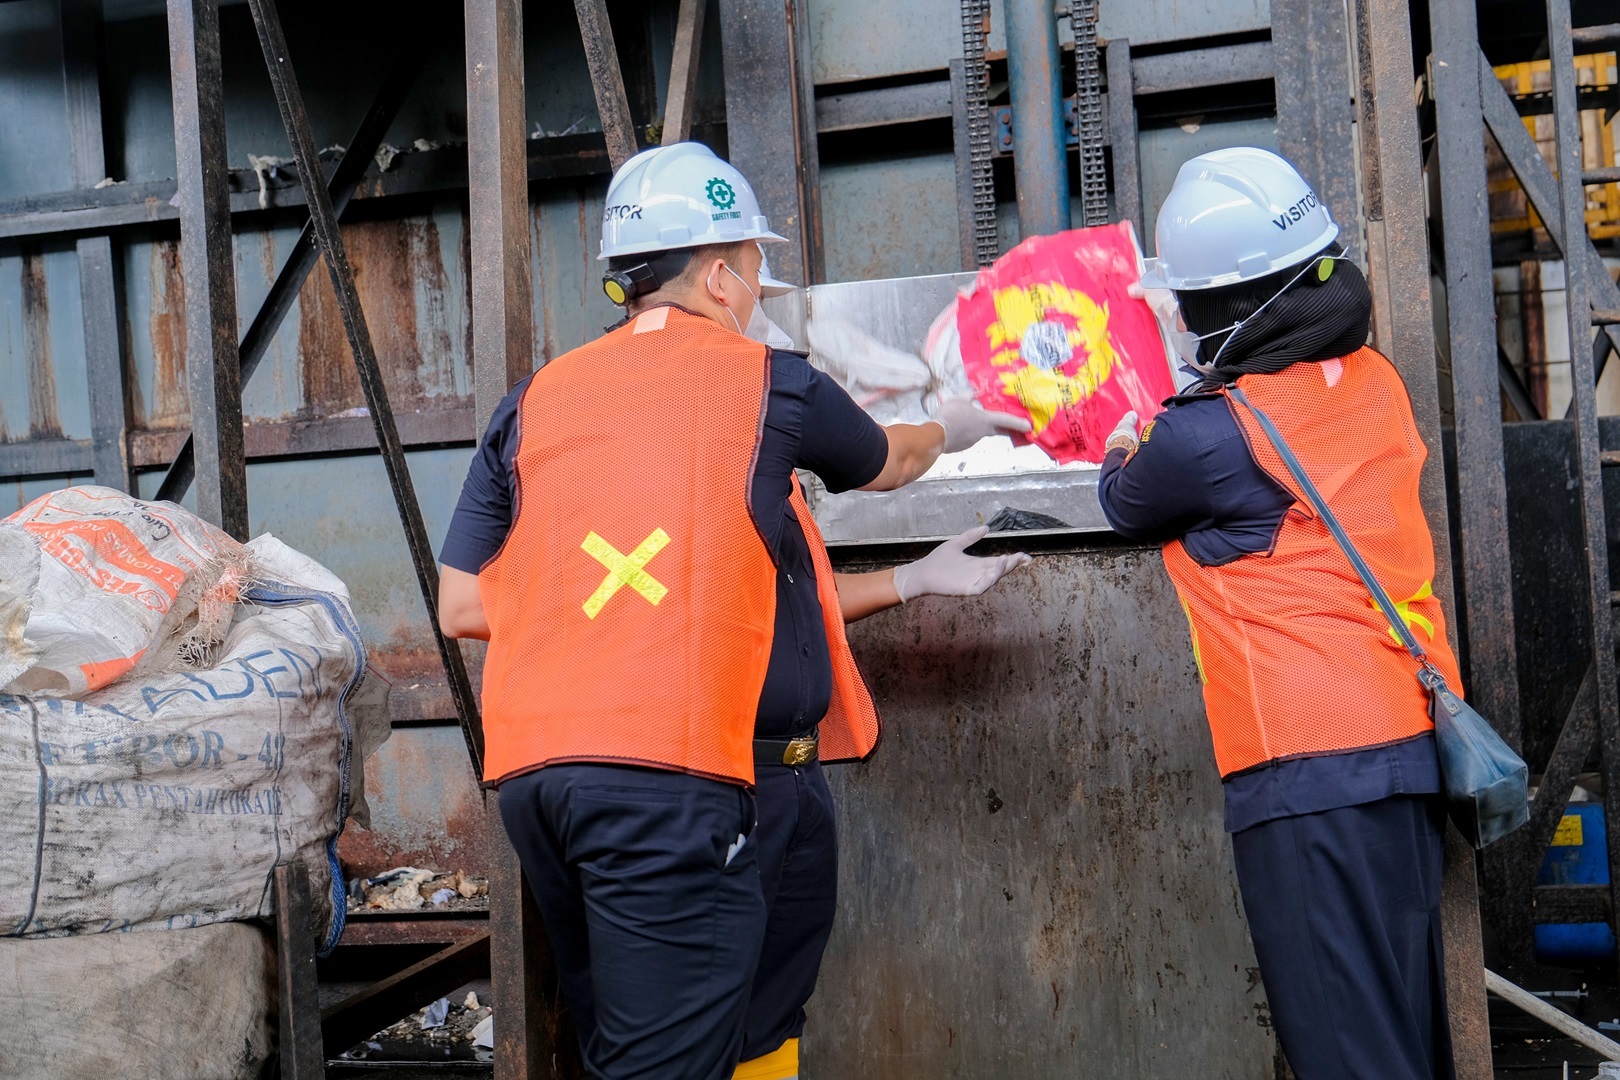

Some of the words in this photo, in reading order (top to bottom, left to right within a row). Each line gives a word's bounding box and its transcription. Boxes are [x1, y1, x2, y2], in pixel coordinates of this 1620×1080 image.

[605, 204, 642, 222] SITOR
[712, 212, 729, 221] SAFETY
[729, 211, 742, 219] FIRST
[1272, 191, 1318, 231] VISITOR
[102, 530, 164, 577] CIOMAS
[257, 731, 286, 770] 48
[38, 776, 127, 808] BORAX
[134, 783, 283, 815] PENTAHYDRATE
